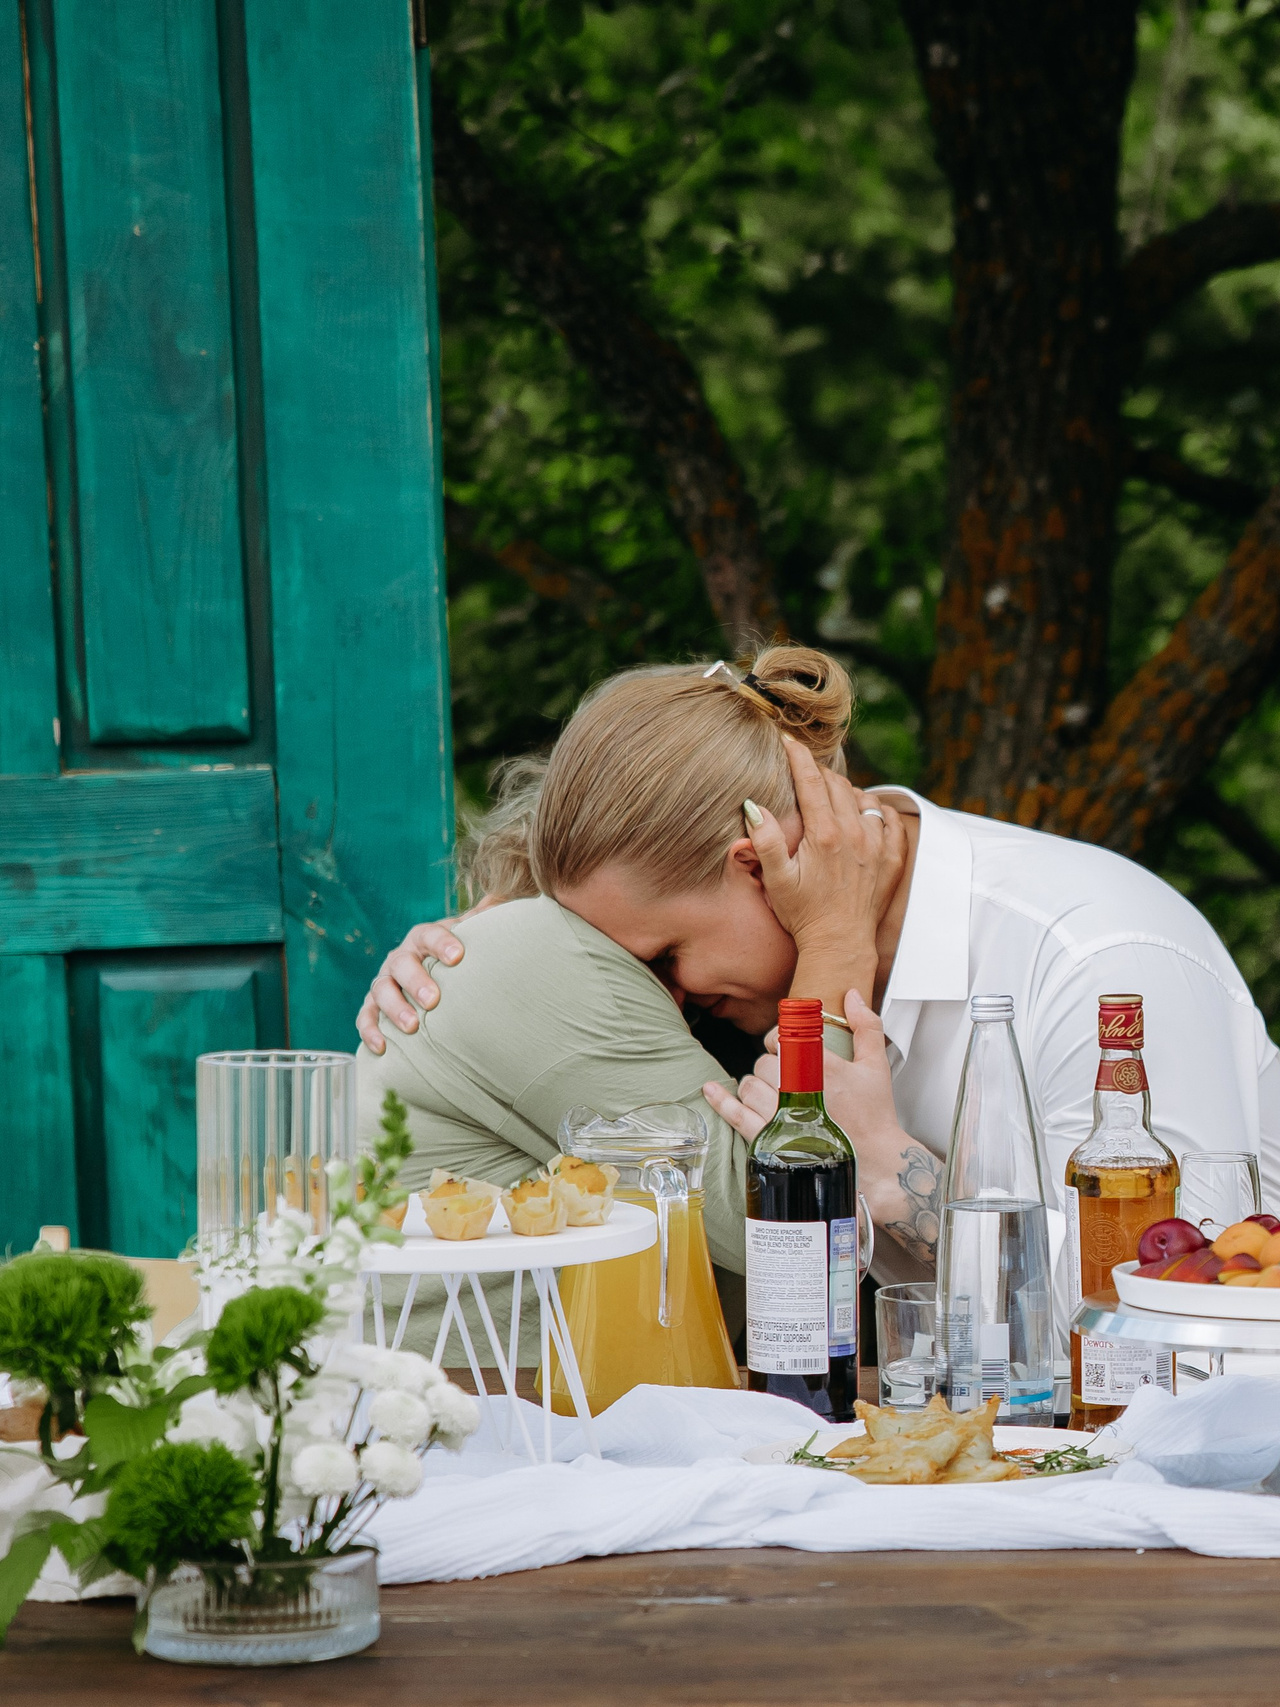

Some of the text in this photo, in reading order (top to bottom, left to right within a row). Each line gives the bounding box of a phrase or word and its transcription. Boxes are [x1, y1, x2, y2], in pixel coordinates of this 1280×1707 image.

[764, 1321, 798, 1332] УПОТРЕБЛЕНИЕ
[799, 1322, 825, 1332] АЛКОГОЛЯ
[764, 1332, 782, 1342] ВАШЕМУ
[783, 1334, 811, 1343] ЗДОРОВЬЮ
